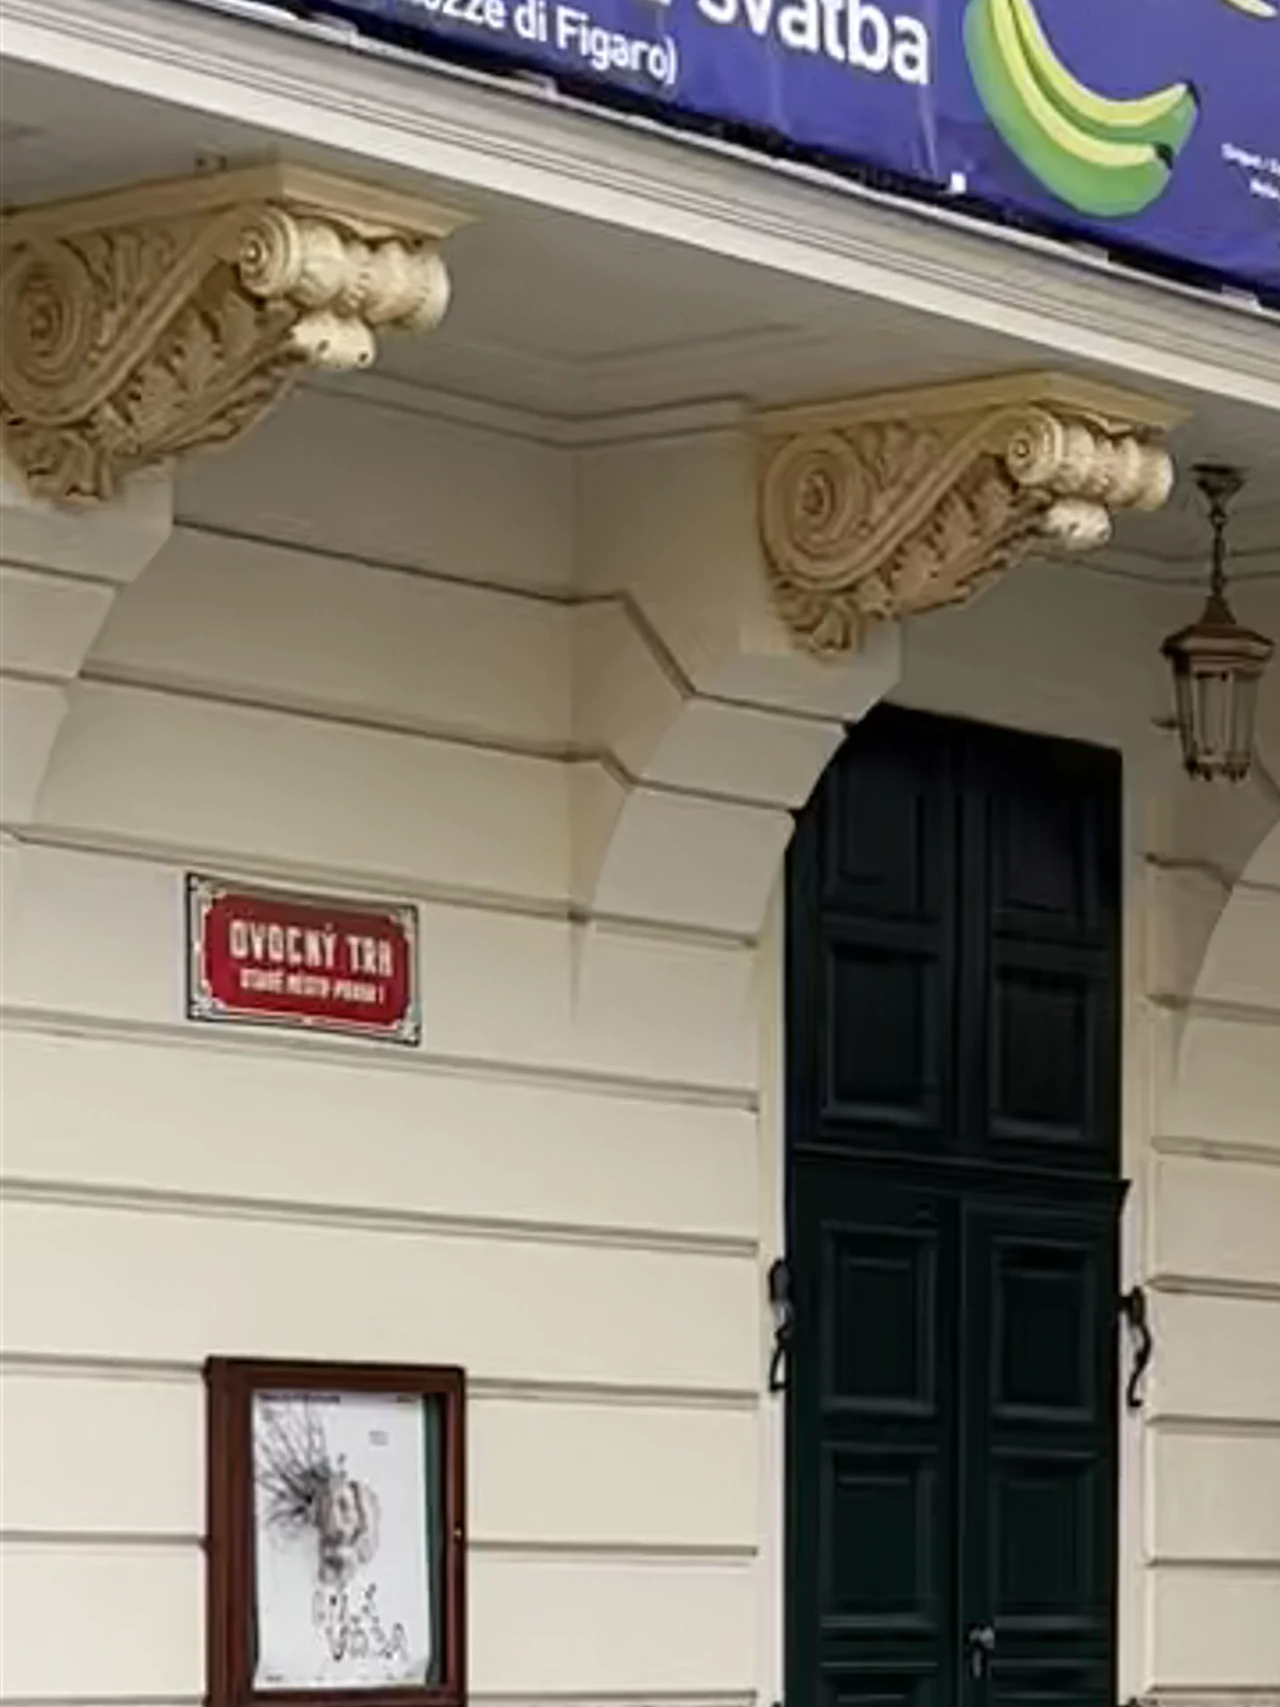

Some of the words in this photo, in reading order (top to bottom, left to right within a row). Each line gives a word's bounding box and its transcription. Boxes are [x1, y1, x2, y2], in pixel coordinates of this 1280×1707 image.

[555, 11, 678, 85] Figaro)
[230, 920, 336, 968] OVOCNÝ
[346, 935, 393, 978] TRH
